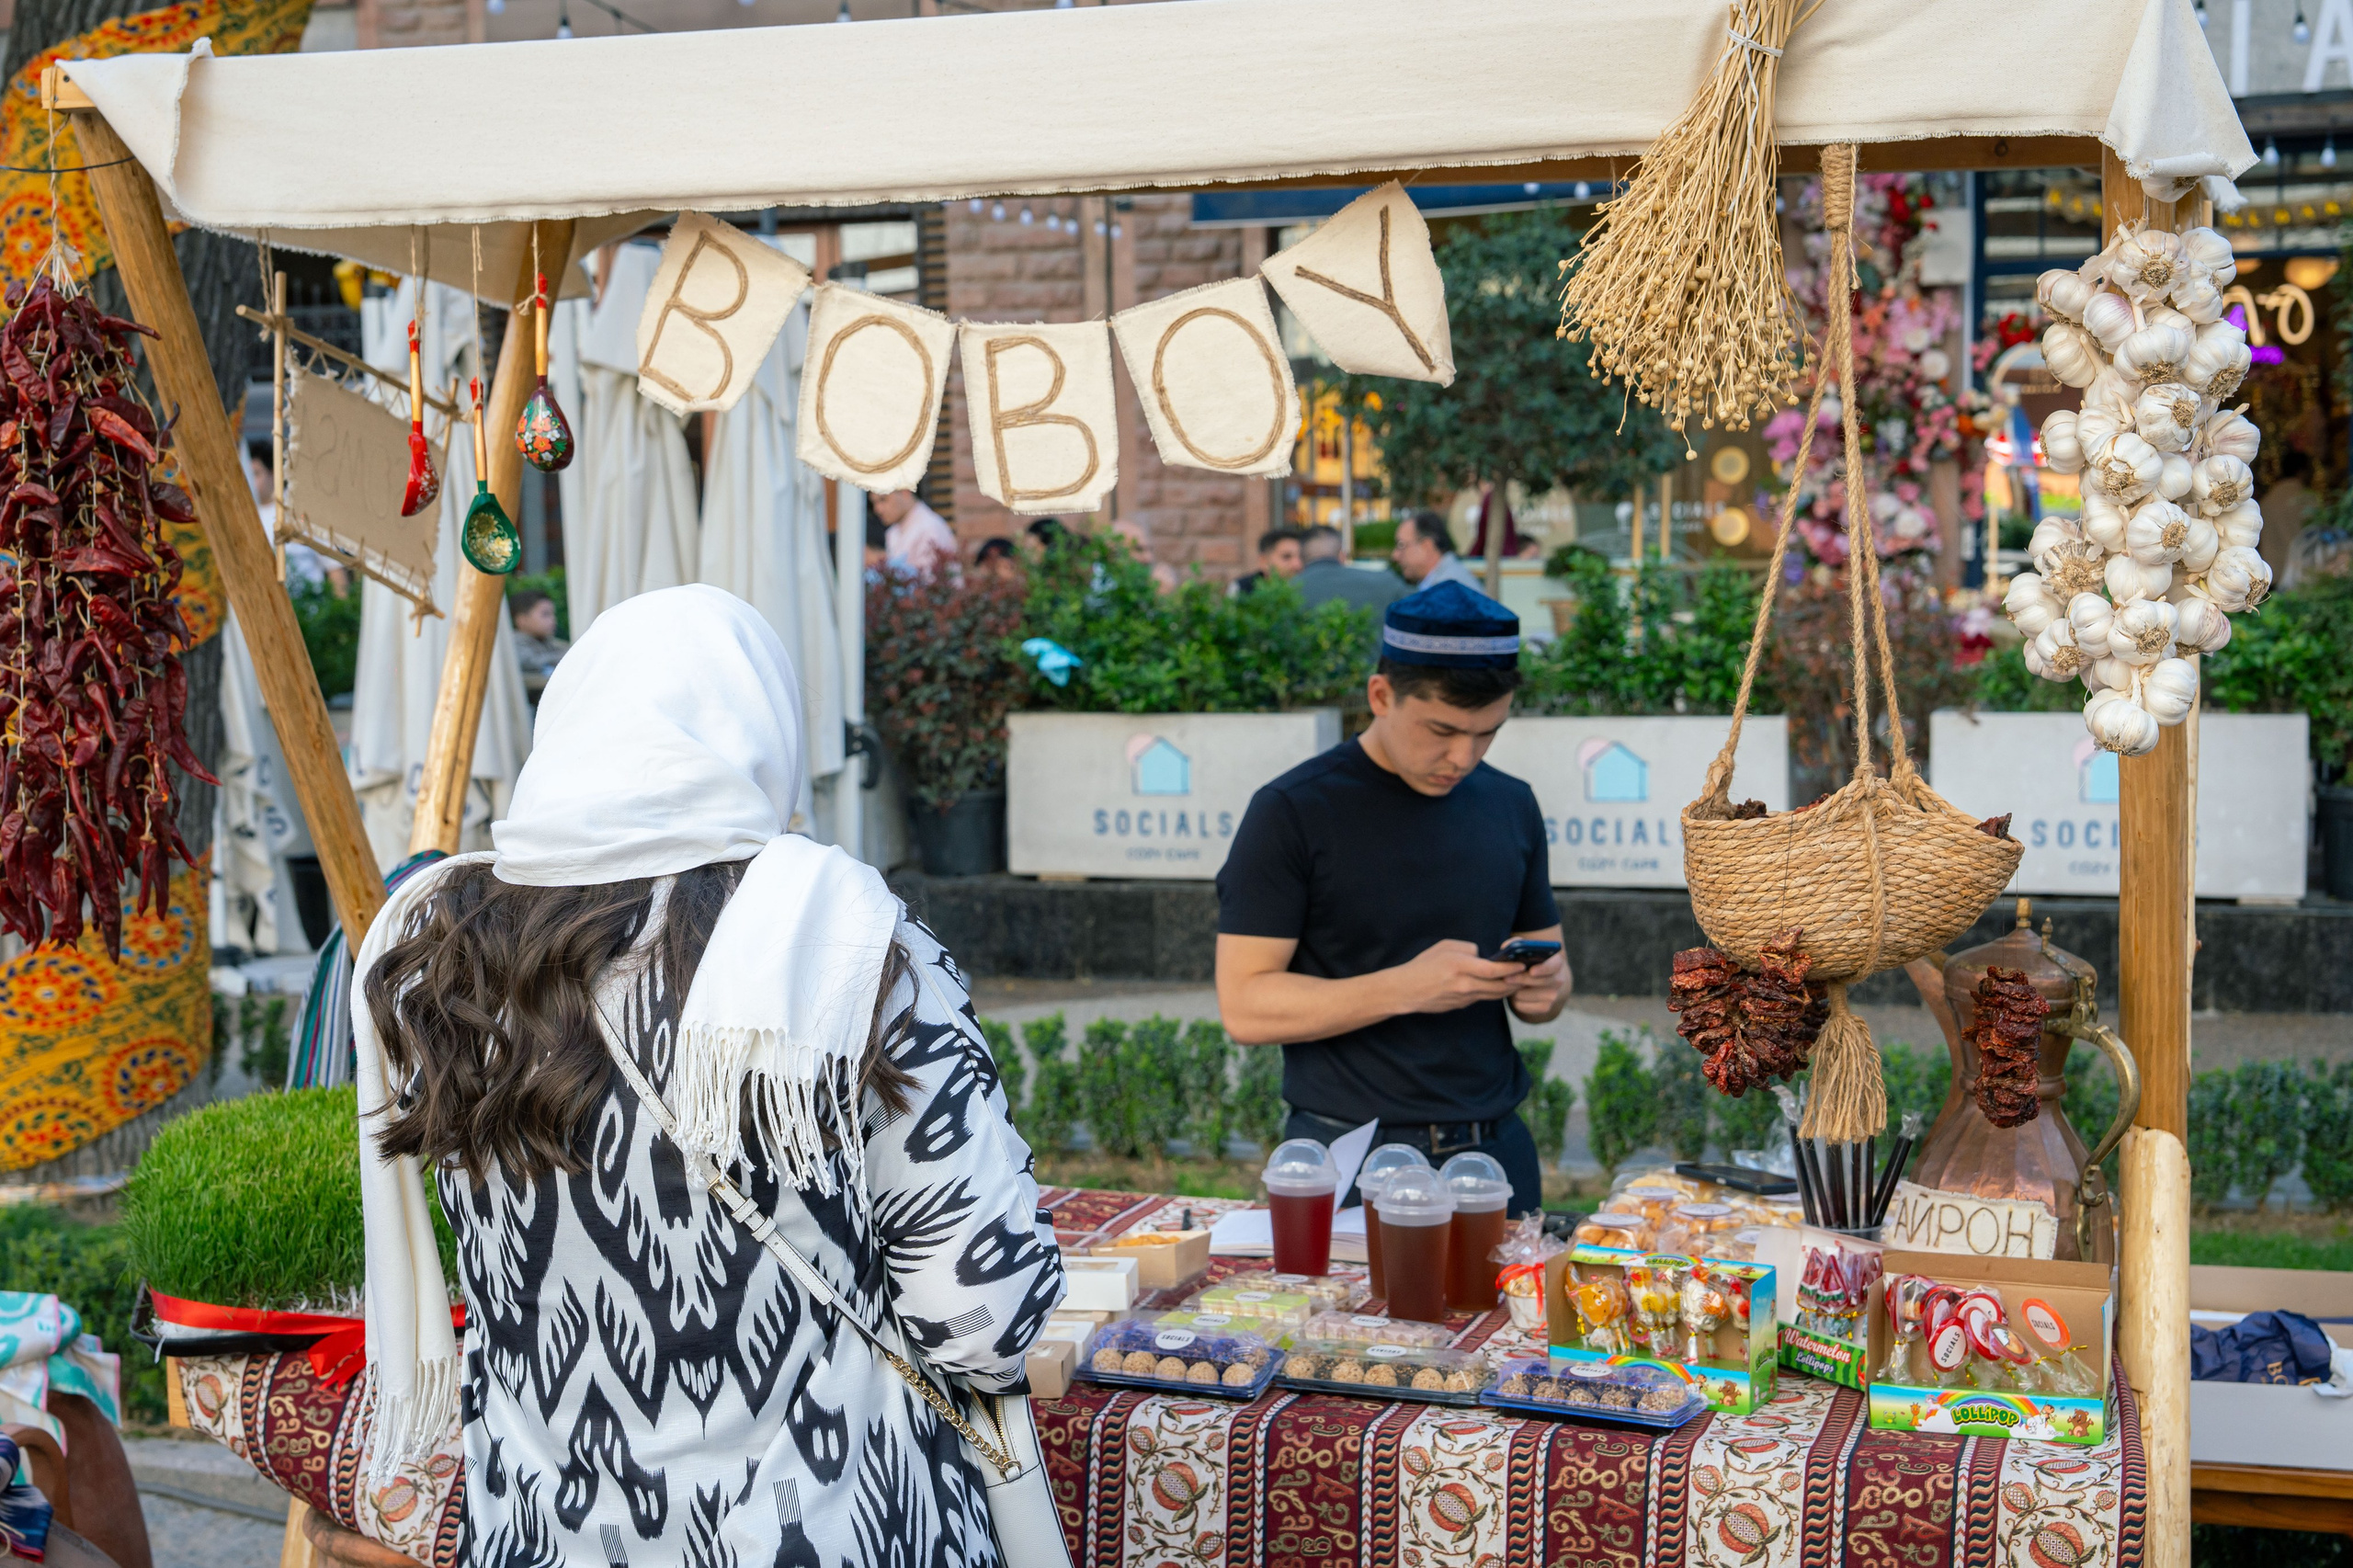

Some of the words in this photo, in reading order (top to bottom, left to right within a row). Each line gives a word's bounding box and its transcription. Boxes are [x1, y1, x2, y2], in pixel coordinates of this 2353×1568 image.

[638, 204, 1437, 502] BOBOY
[1093, 808, 1233, 839] SOCIALS
[1544, 816, 1684, 847] SOCIAL
[1161, 1334, 1191, 1342] SOCIALS
[2031, 1319, 2055, 1331] SOCIALS
[1784, 1327, 1851, 1364] Watermelon
[1940, 1331, 1961, 1363] SOCIALS
[1795, 1350, 1835, 1373] Lollipops
